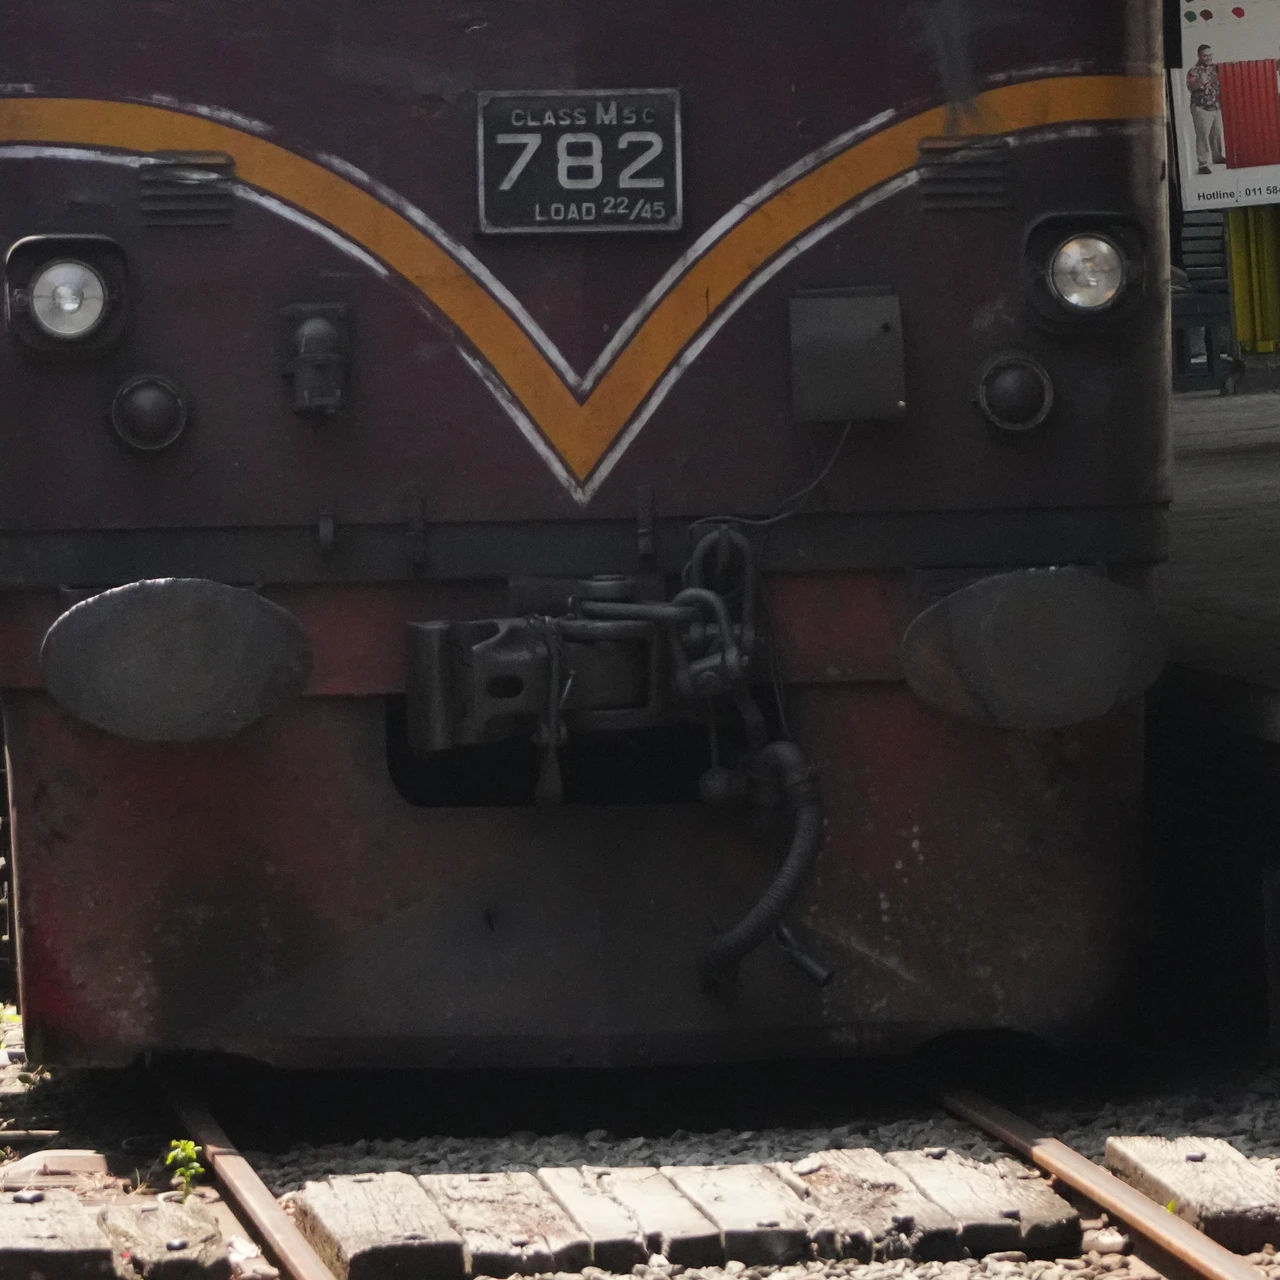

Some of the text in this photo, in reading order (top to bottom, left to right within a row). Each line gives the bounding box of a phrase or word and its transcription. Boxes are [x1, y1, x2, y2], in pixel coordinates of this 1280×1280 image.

[511, 108, 587, 126] CLASS
[496, 131, 665, 191] 782
[1197, 191, 1235, 201] Hotline
[1245, 187, 1263, 197] 011
[535, 196, 666, 221] LOAD 22/45
